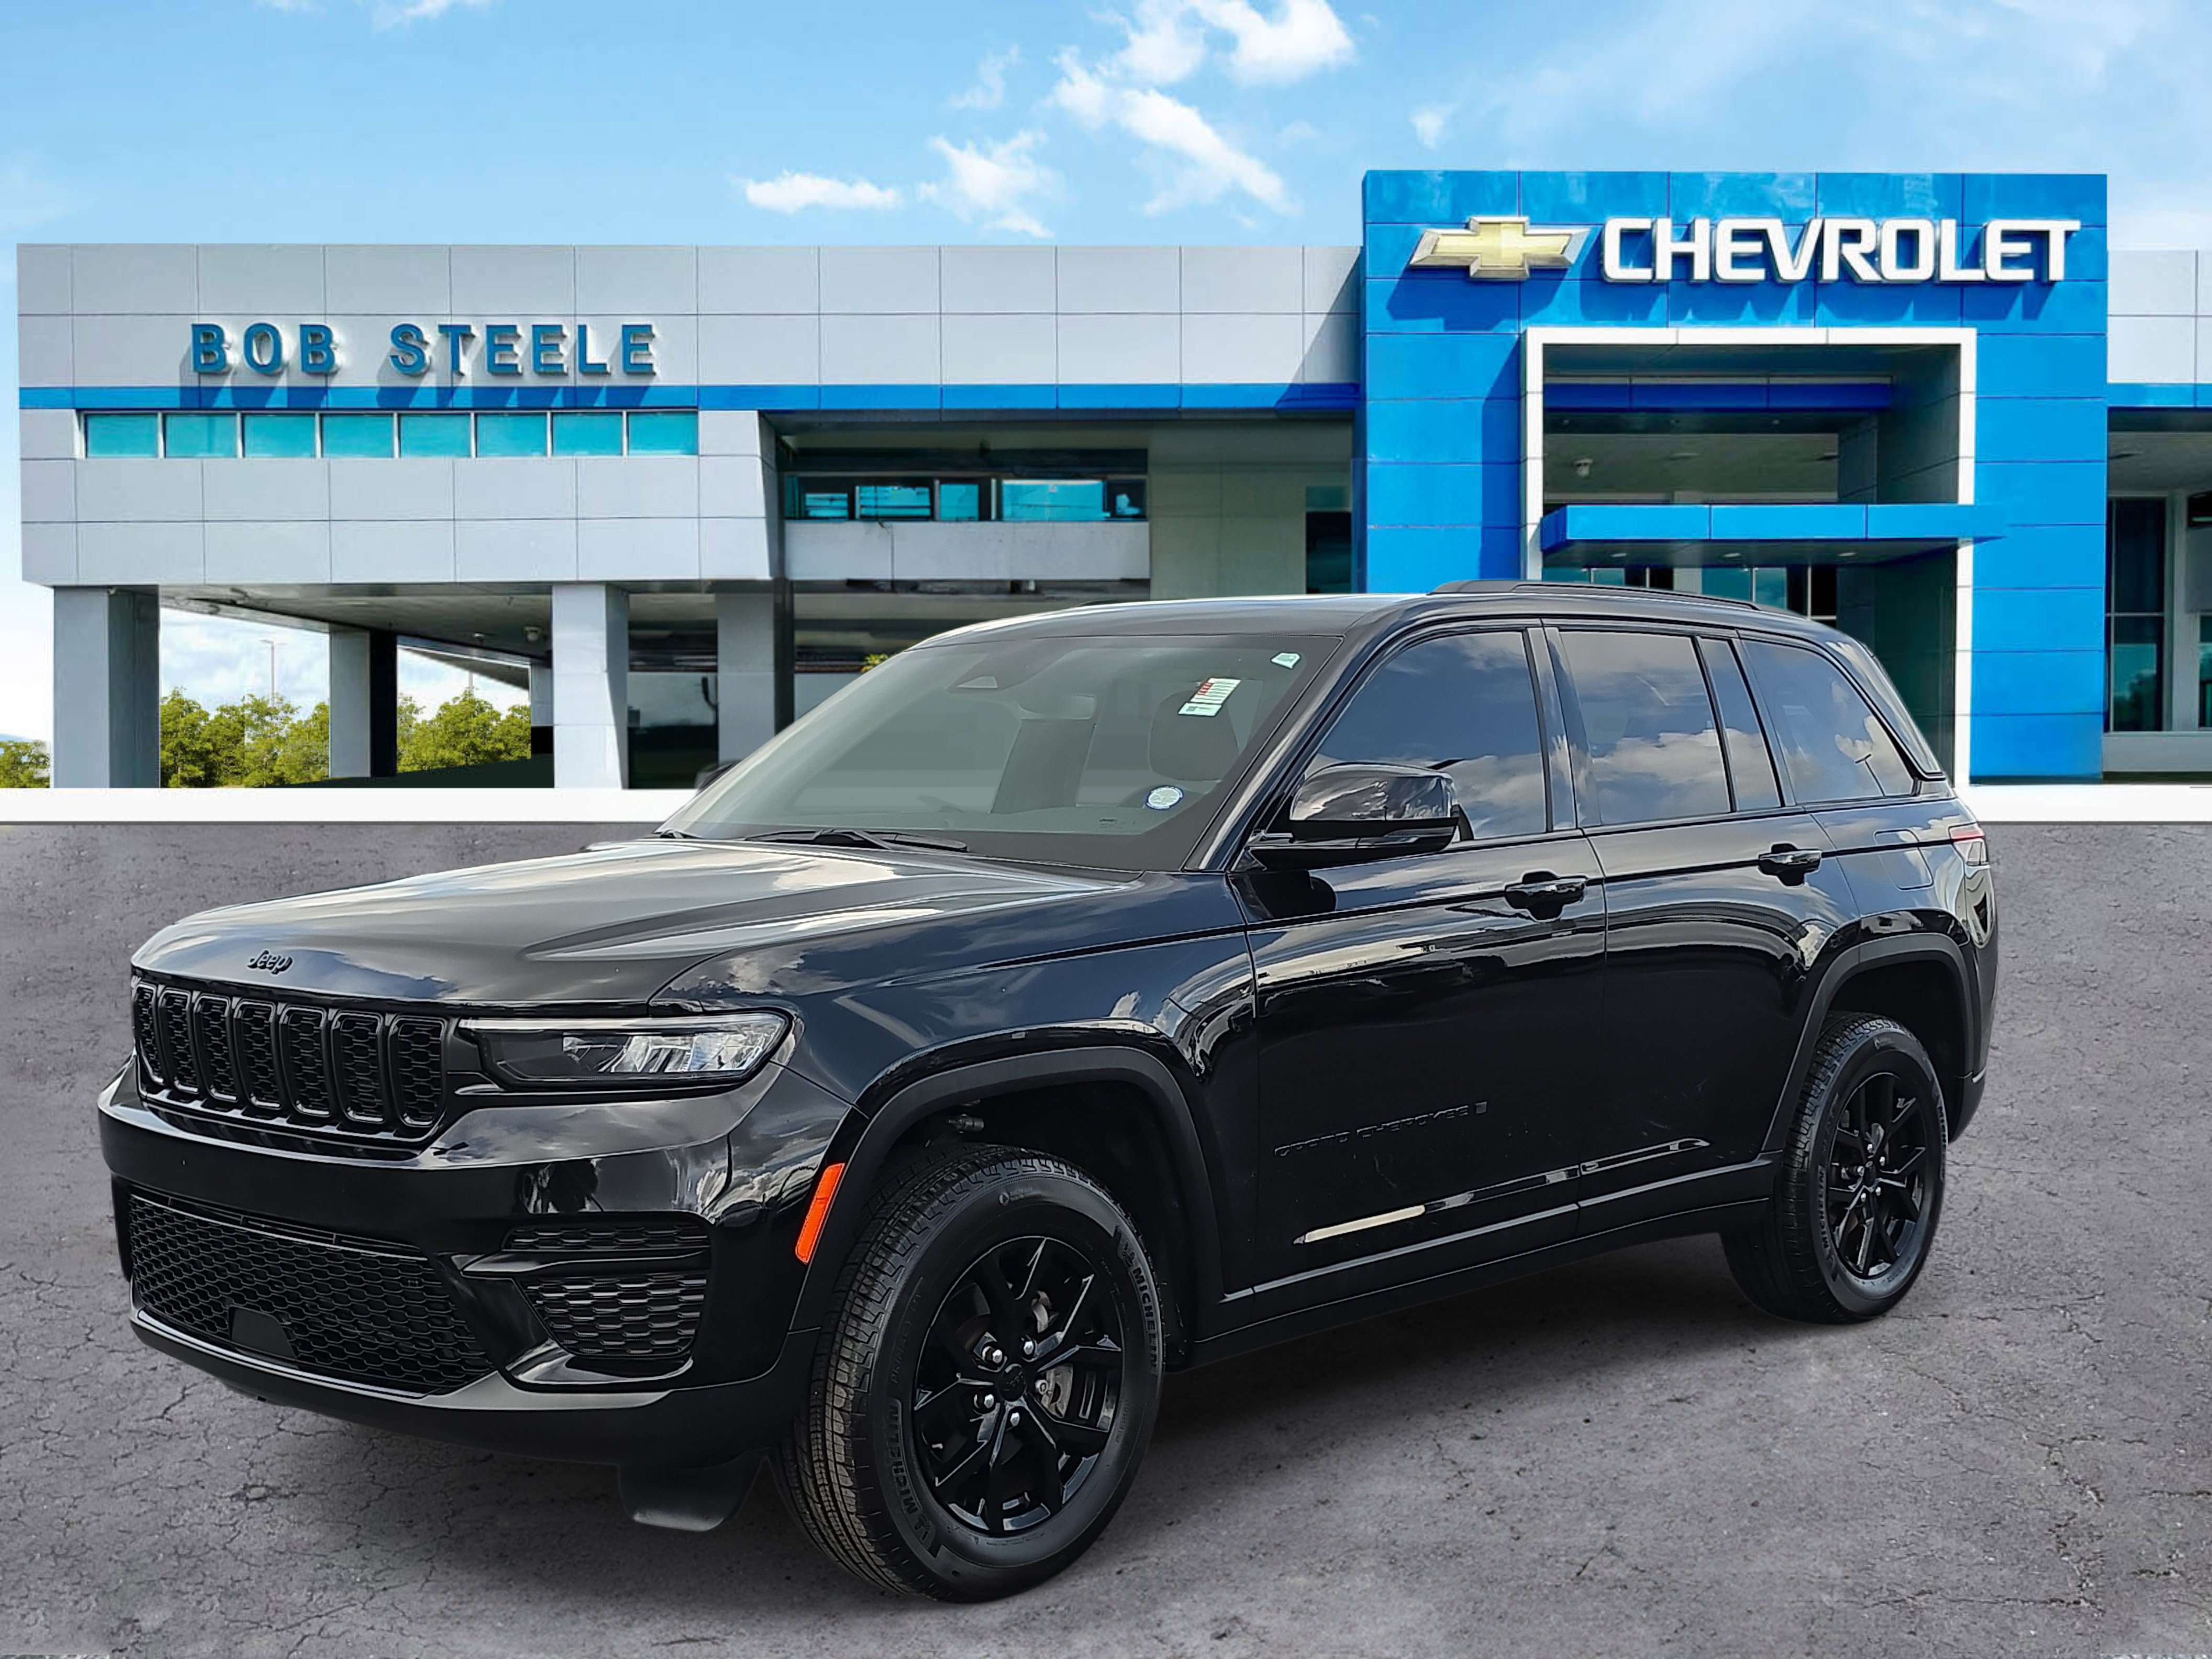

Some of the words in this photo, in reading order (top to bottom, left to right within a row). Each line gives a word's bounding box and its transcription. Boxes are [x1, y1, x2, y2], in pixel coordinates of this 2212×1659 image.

[1602, 216, 2081, 283] CHEVROLET
[191, 323, 339, 374] BOB
[389, 323, 657, 375] STEELE
[247, 949, 293, 975] Jeep
[1132, 1267, 1158, 1369] MICHELIN
[887, 1406, 919, 1516] MICHELIN
